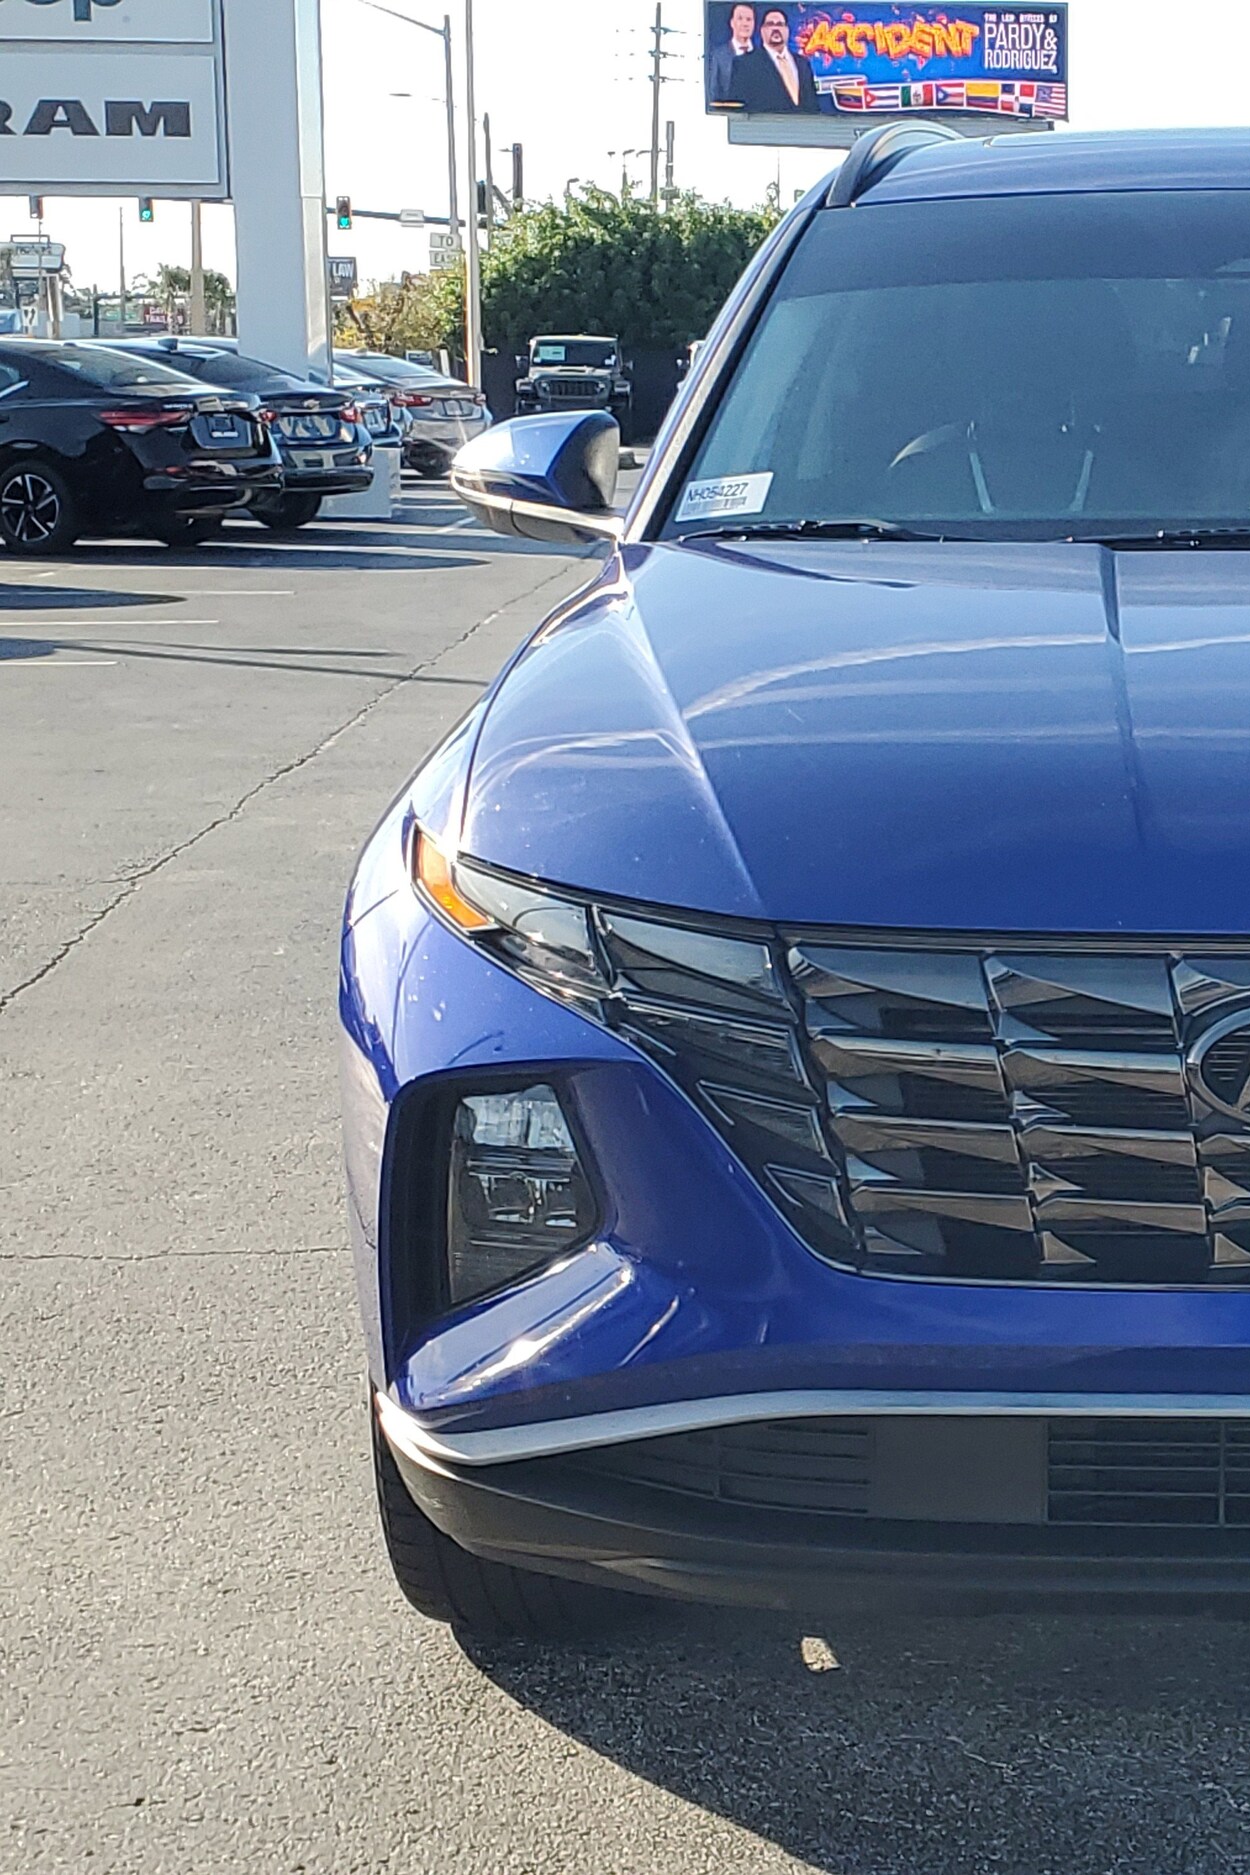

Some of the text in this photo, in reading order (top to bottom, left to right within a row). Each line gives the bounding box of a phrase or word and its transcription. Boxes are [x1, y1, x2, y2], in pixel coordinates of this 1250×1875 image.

[804, 20, 980, 59] ACCIDENT
[984, 49, 1058, 70] RODRIGUEZ
[0, 99, 191, 137] AM
[438, 235, 454, 247] TO
[332, 262, 354, 278] LAW
